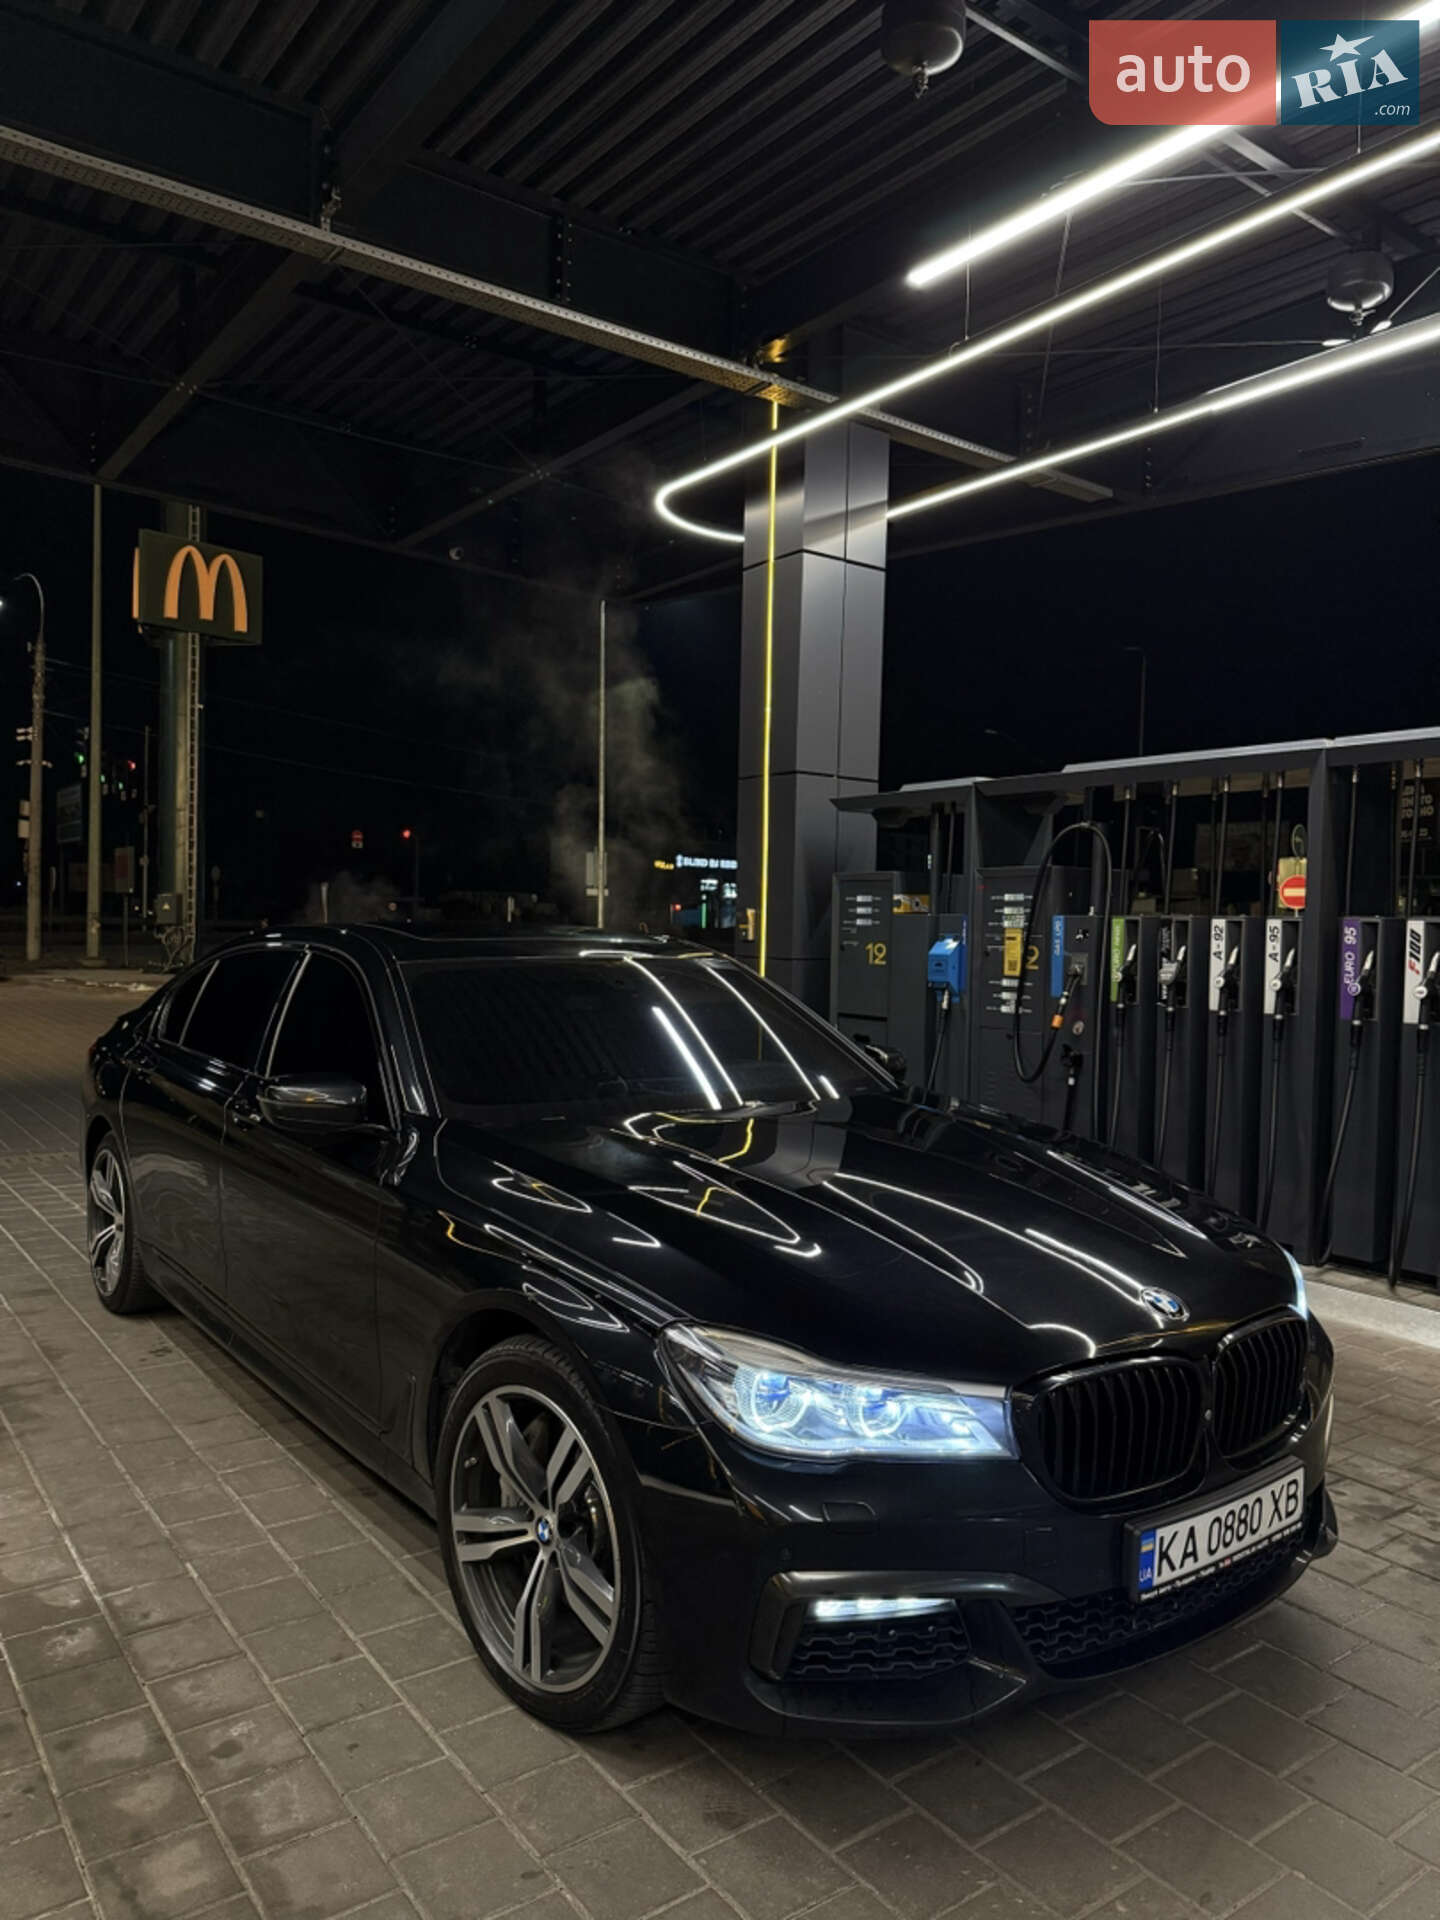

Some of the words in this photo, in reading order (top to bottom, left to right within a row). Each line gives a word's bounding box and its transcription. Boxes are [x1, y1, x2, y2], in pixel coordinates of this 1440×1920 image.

[1343, 926, 1358, 945] 95
[864, 941, 887, 966] 12
[1343, 951, 1356, 985] EURO
[1157, 1525, 1198, 1577] KA
[1207, 1497, 1263, 1556] 0880
[1267, 1478, 1299, 1529] XB
